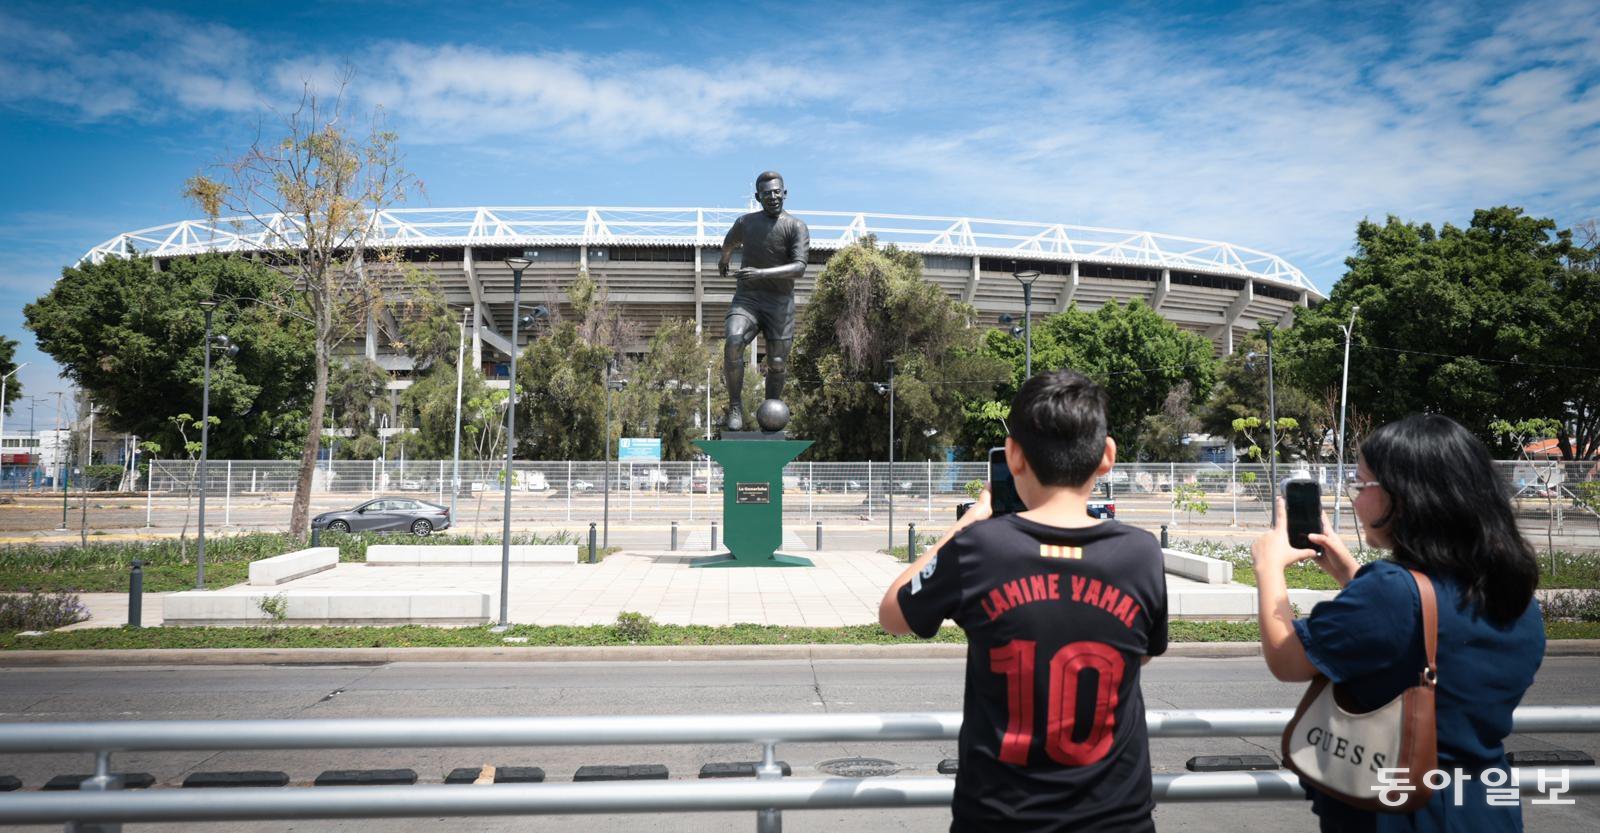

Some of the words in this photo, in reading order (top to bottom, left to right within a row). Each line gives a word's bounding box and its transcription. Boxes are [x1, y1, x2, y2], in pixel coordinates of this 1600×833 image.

[980, 573, 1061, 621] LAMINE
[1071, 575, 1141, 629] YAMAL
[989, 639, 1126, 766] 10
[1306, 726, 1386, 774] GUESS
